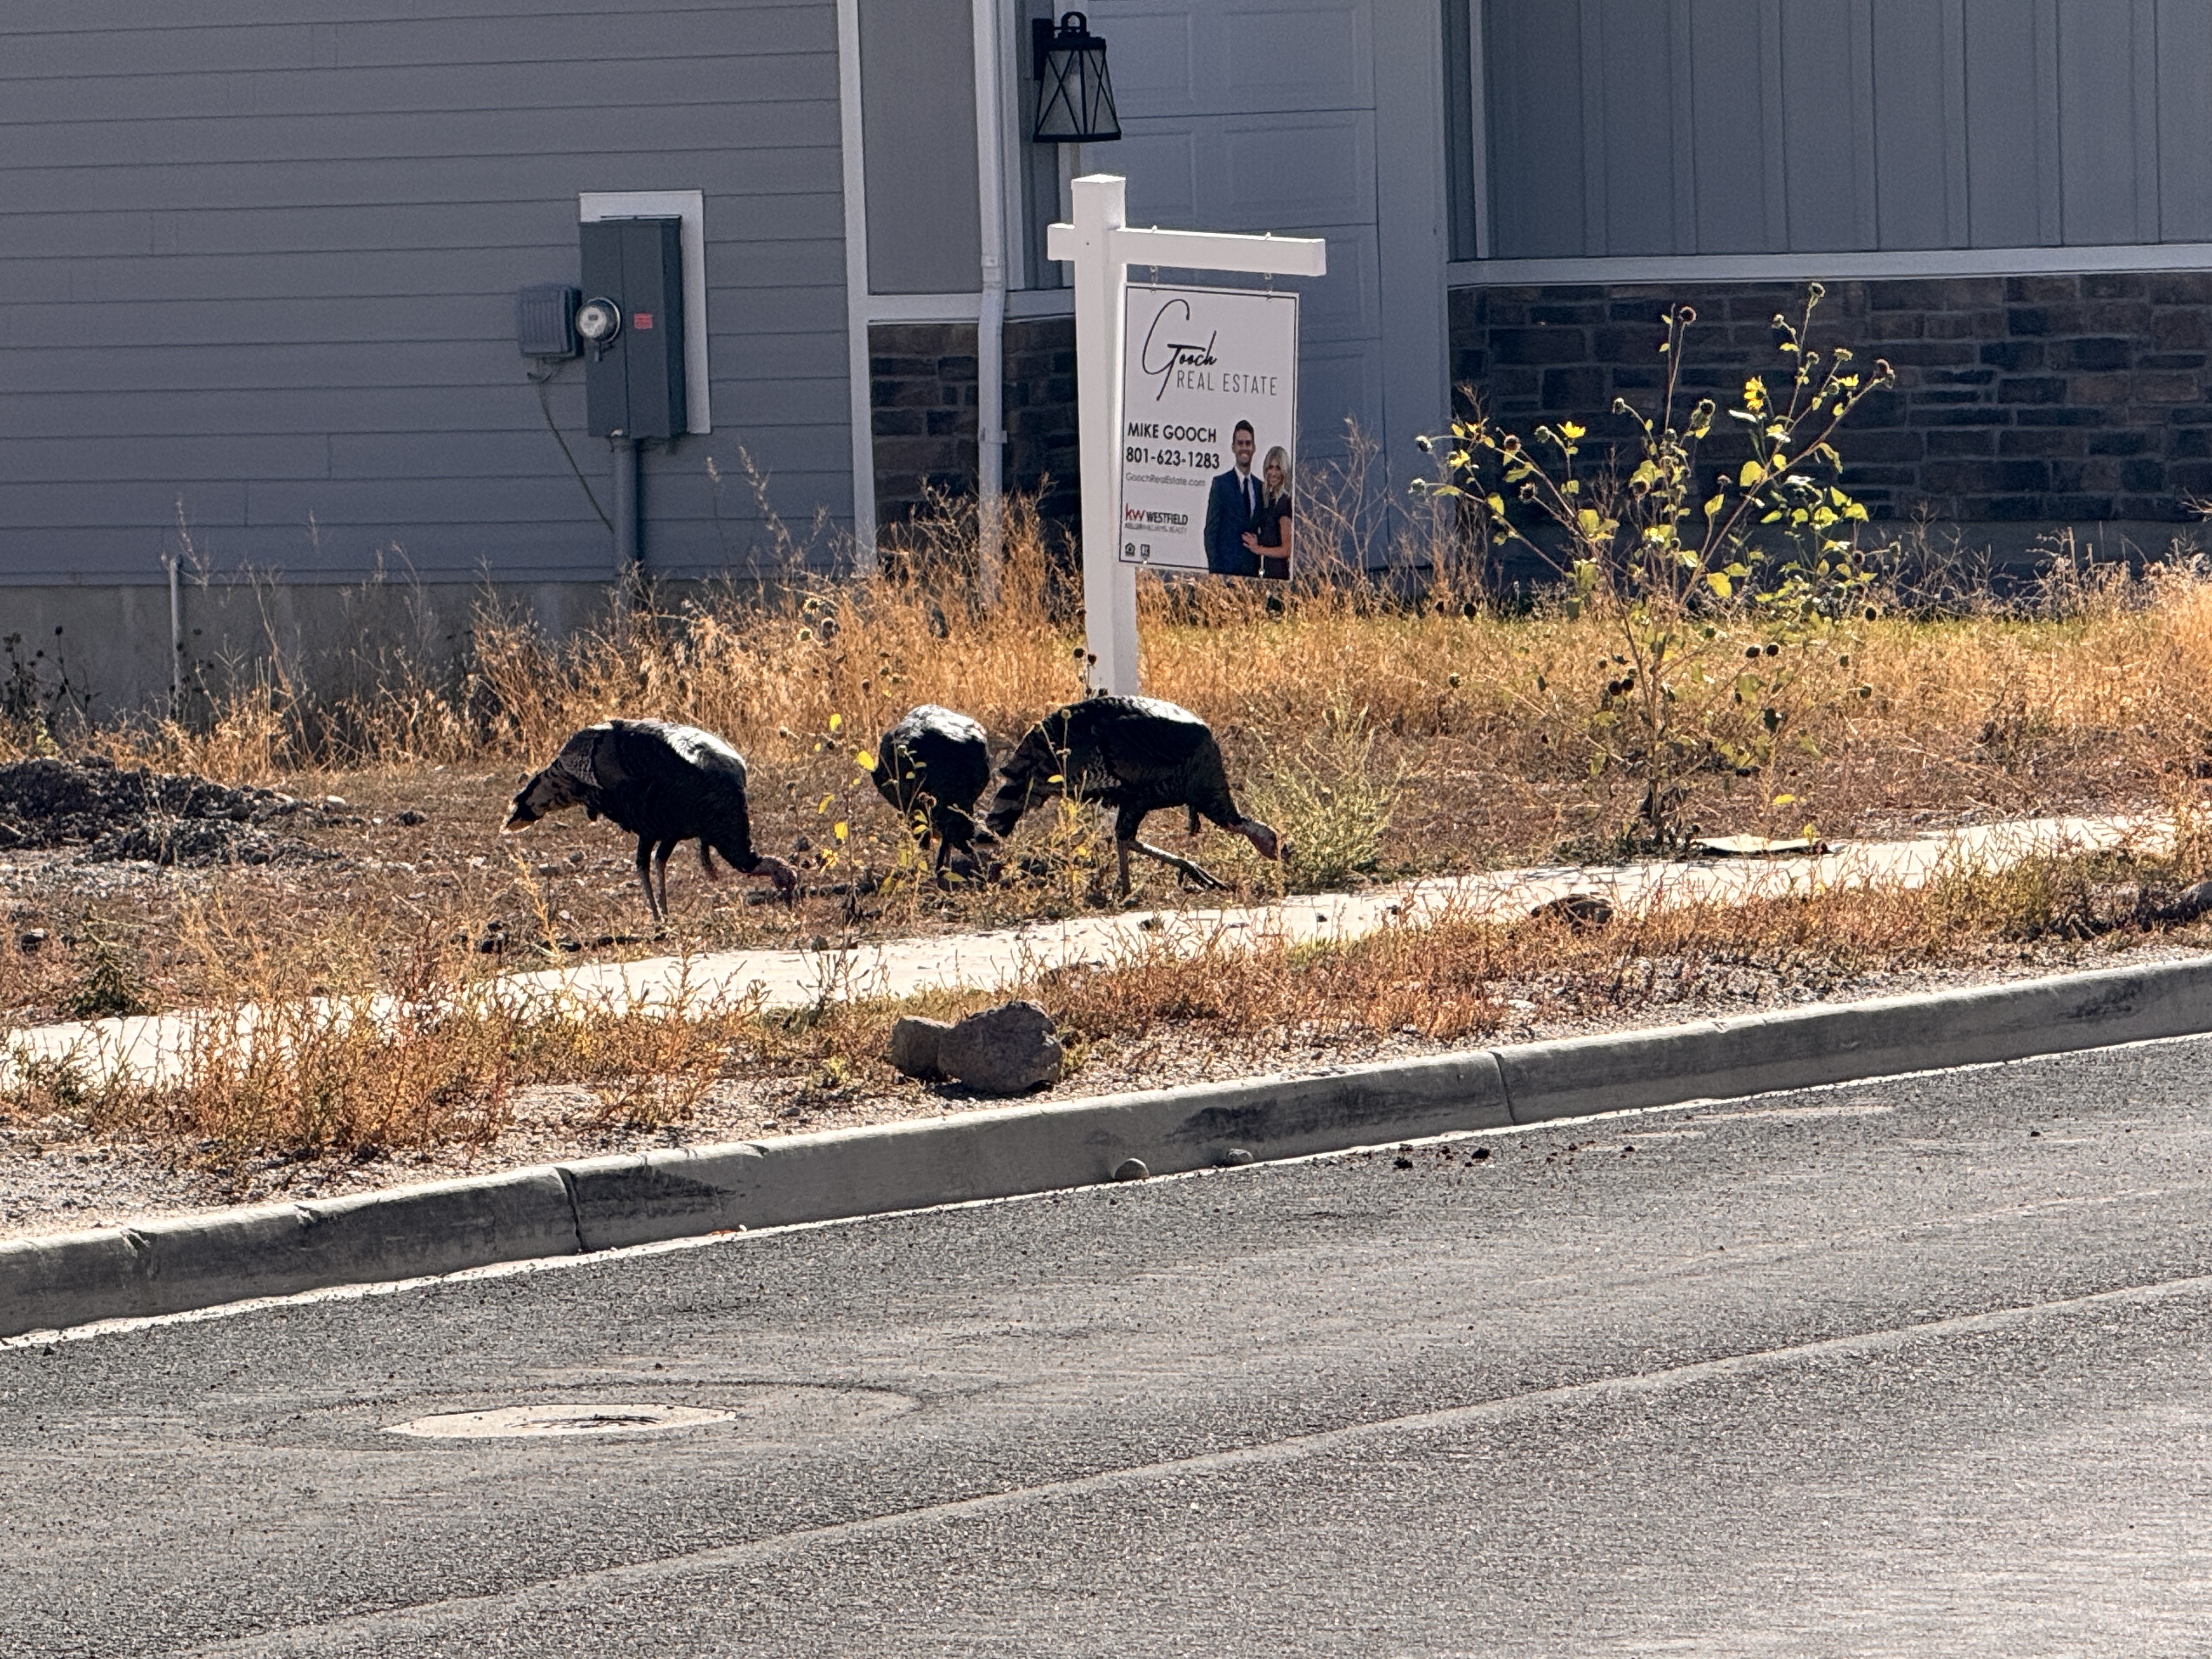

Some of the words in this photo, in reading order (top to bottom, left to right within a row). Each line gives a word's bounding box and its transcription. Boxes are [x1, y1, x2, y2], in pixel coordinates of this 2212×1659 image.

[1142, 298, 1217, 401] Gooch
[1177, 370, 1215, 391] REAL
[1223, 373, 1278, 396] ESTATE
[1127, 422, 1159, 438] MIKE
[1163, 425, 1216, 443] GOOCH
[1126, 447, 1220, 469] 801-623-1283
[1146, 511, 1188, 525] WESTFIELD
